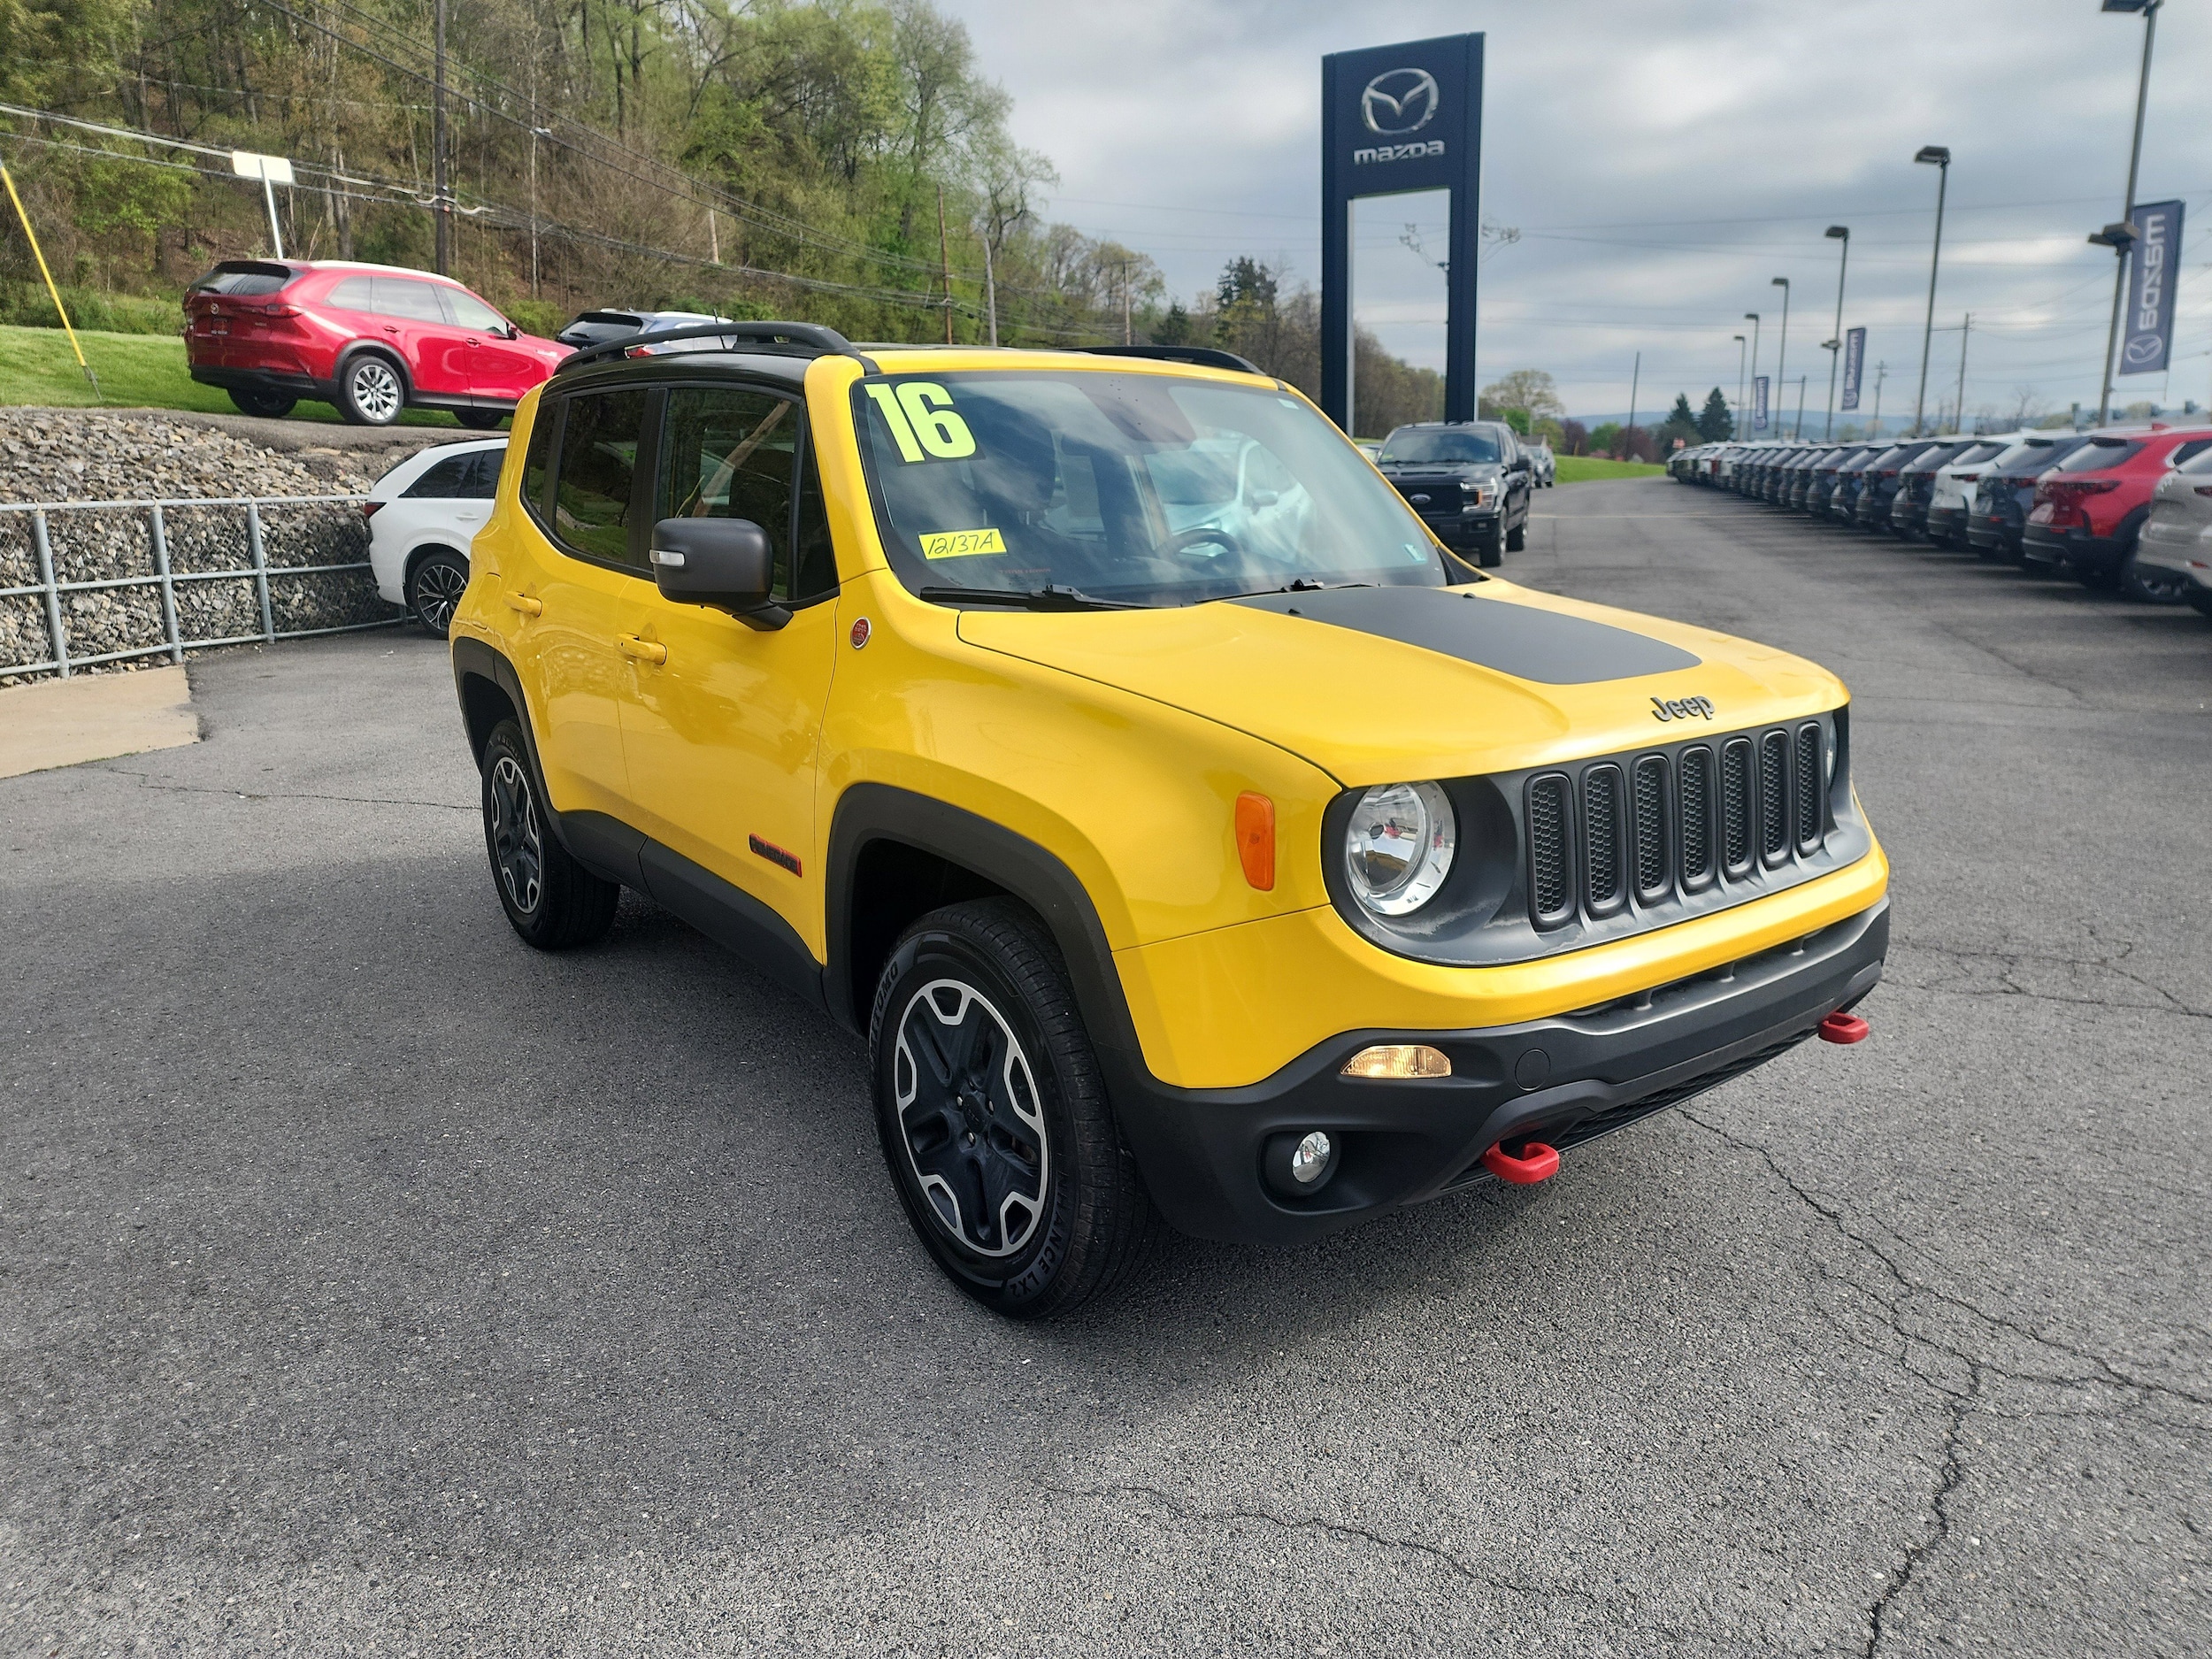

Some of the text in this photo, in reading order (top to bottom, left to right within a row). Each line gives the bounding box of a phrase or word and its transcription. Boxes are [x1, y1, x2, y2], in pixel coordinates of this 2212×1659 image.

[1353, 139, 1446, 165] mazda
[864, 381, 977, 463] 16
[927, 532, 996, 556] 12137A
[1649, 695, 1716, 722] Jeep
